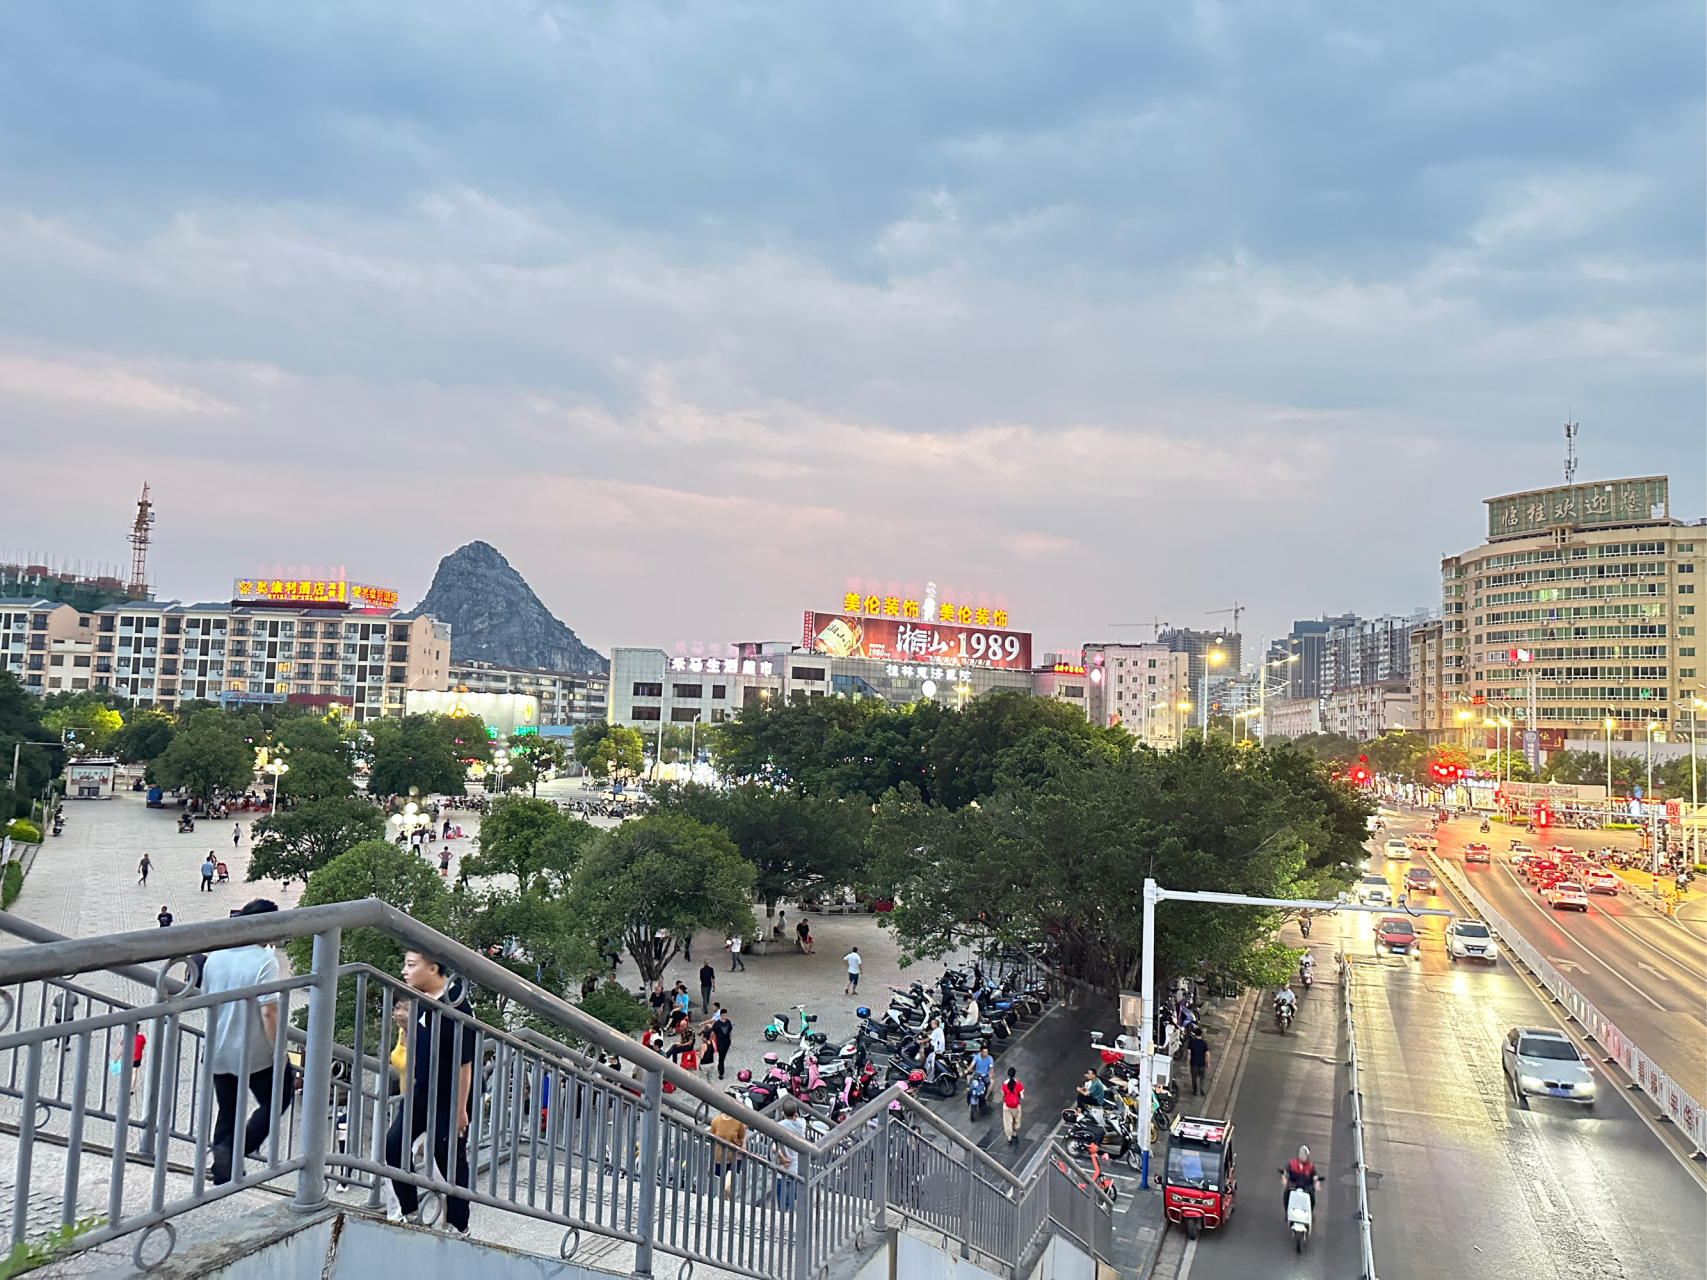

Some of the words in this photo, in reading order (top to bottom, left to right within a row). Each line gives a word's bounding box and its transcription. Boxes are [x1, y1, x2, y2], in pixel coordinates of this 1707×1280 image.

[1501, 490, 1643, 527] 临桂欢迎您
[843, 592, 919, 619] 美伦装饰
[939, 603, 1009, 628] 美伦装饰
